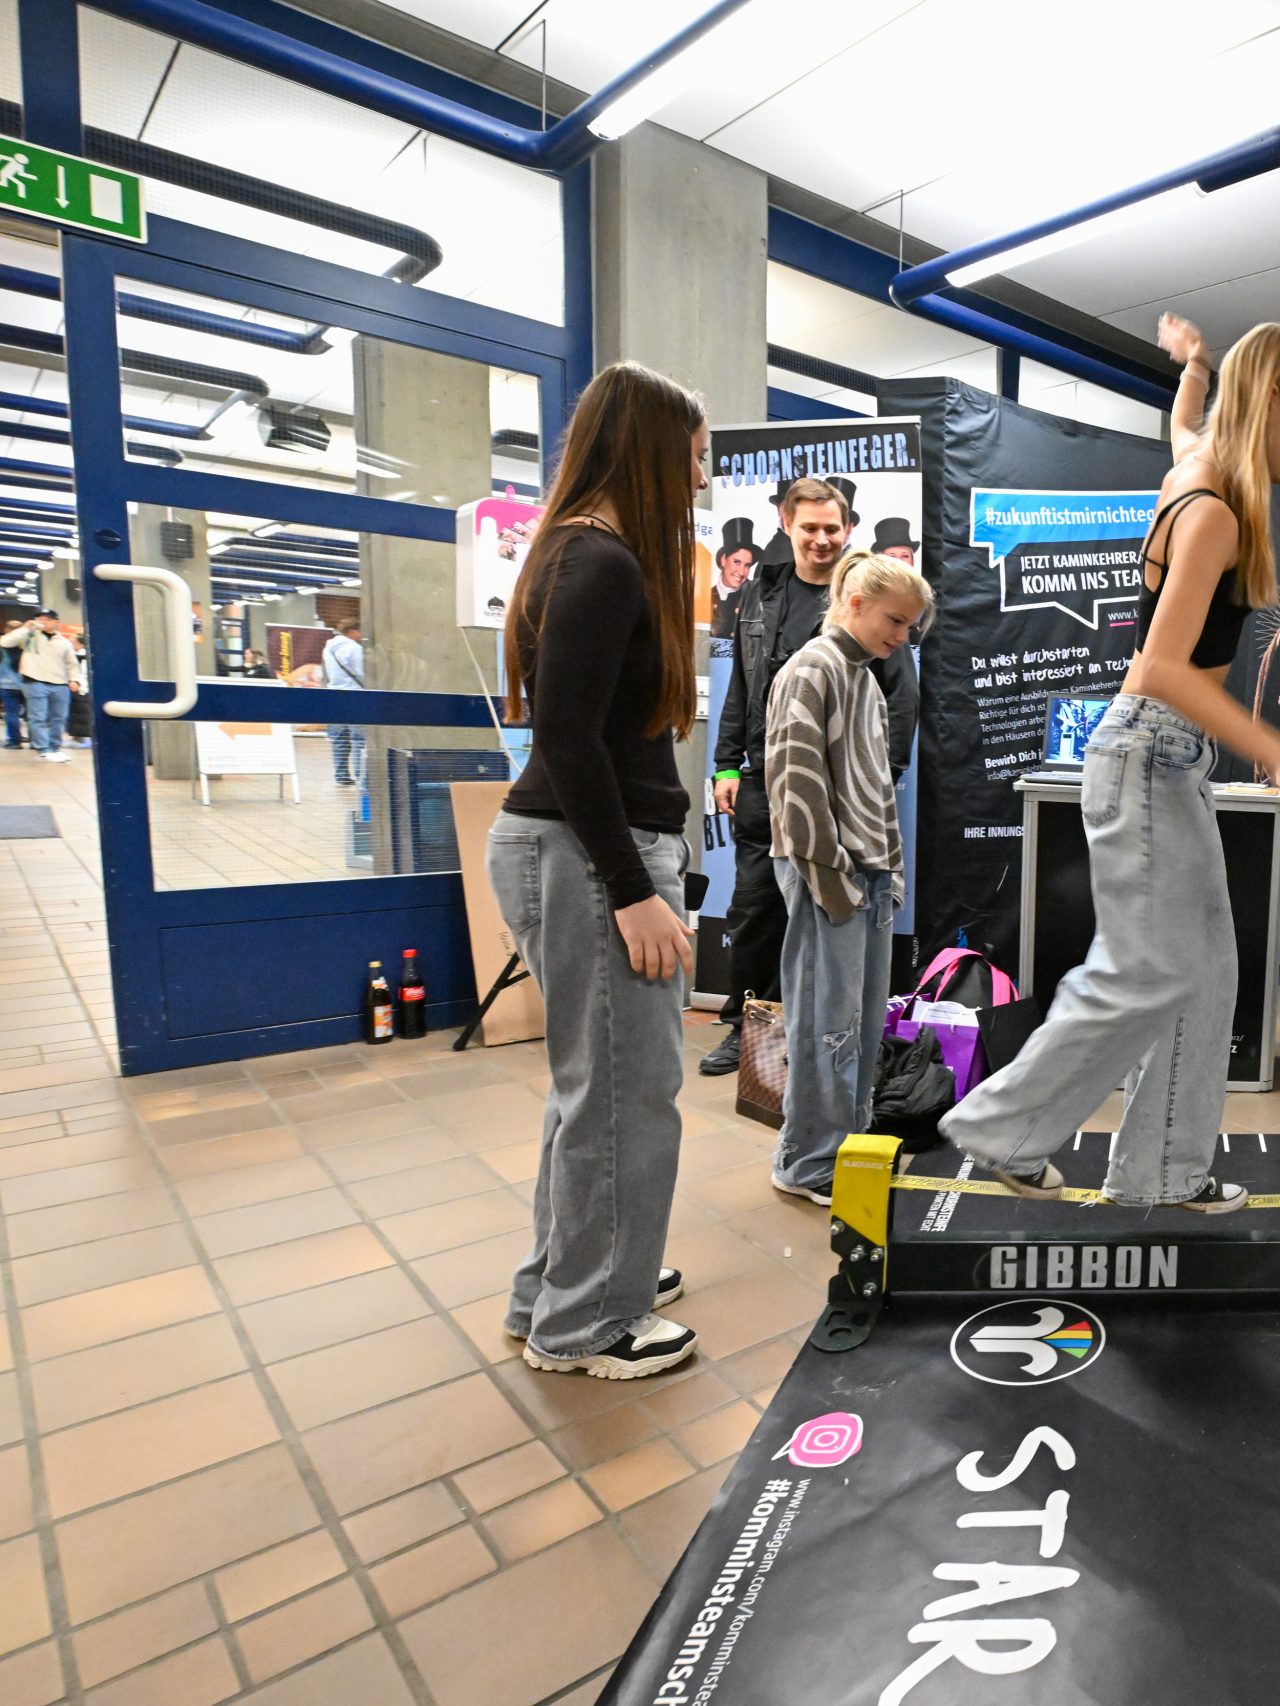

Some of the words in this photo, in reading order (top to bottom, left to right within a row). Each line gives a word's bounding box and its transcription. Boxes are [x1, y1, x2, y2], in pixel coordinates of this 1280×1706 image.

[720, 432, 916, 489] SCHORNSTEINFEGER.
[1020, 554, 1050, 572] JETZT
[1021, 574, 1077, 594] KOMM
[1081, 571, 1109, 590] INS
[1111, 569, 1142, 588] TEA
[1108, 608, 1139, 621] www.k
[972, 656, 987, 671] Du
[990, 652, 1018, 668] willst
[1023, 646, 1090, 664] durchstarten
[974, 674, 993, 689] und
[995, 671, 1018, 686] bist
[1022, 665, 1084, 683] interessiert
[1088, 662, 1102, 674] an
[1105, 657, 1131, 671] Tech
[977, 697, 1004, 707] Warum
[1005, 694, 1020, 704] eine
[1070, 680, 1124, 693] Kaminkehrerha
[1020, 703, 1036, 714] dich
[981, 719, 1028, 733] Technologien
[990, 735, 1004, 745] den
[985, 753, 1017, 769] Bewirb
[1018, 750, 1037, 762] Dich
[964, 826, 986, 838] IHRE
[990, 1245, 1178, 1290] GIBBON
